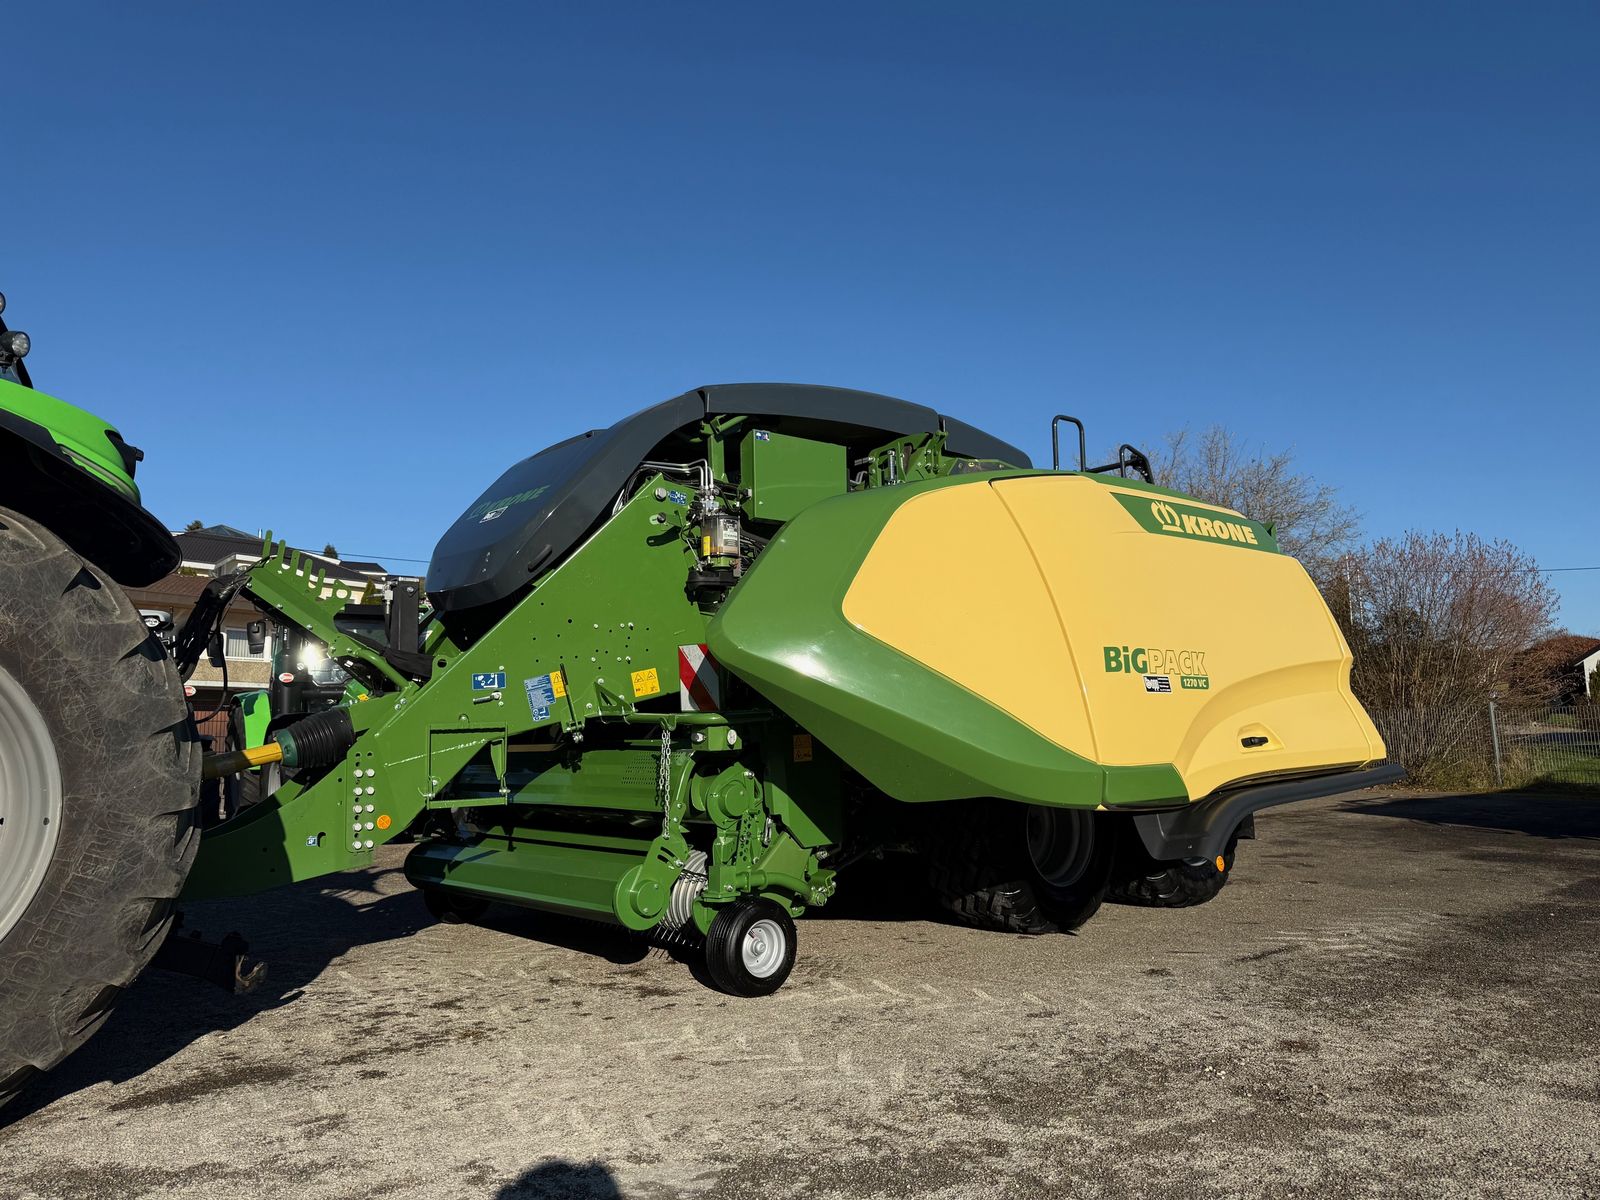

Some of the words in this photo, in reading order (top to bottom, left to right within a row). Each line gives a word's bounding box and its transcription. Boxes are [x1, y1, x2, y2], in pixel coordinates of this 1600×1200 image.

[1181, 514, 1258, 545] KRONE
[1183, 678, 1197, 688] 1270
[1197, 678, 1207, 688] VC
